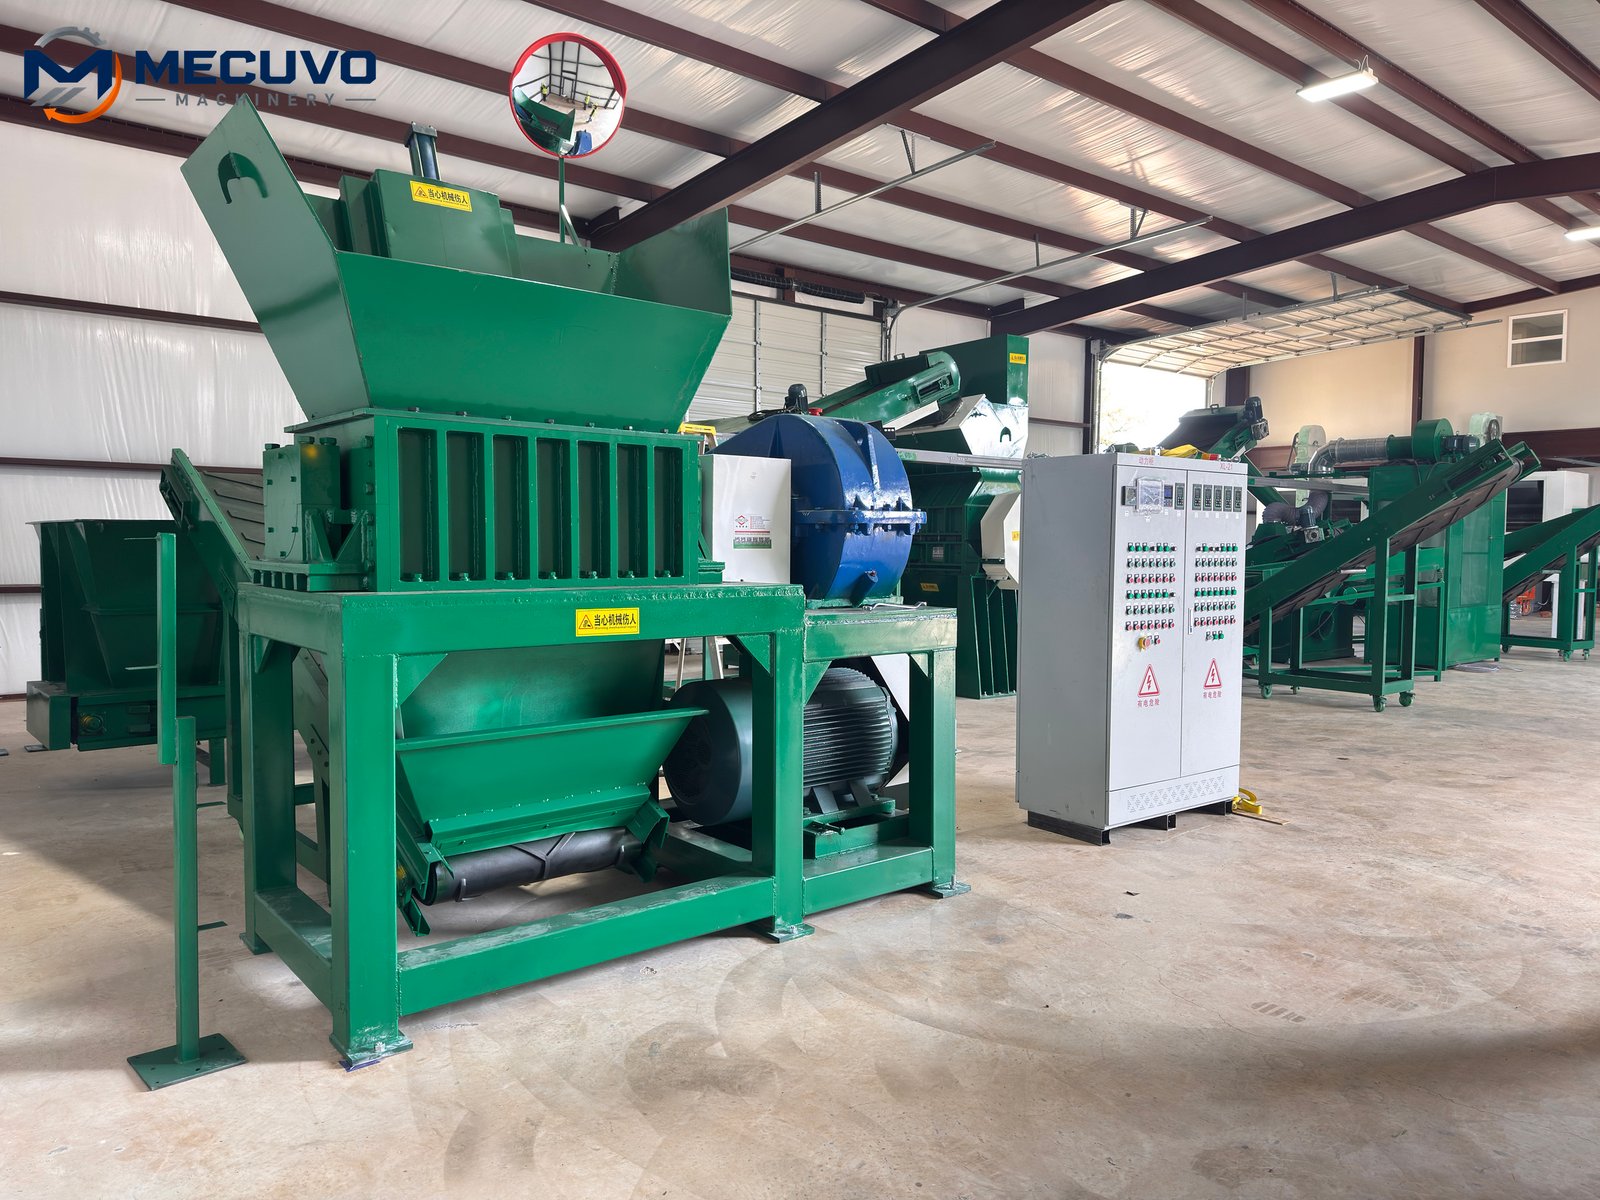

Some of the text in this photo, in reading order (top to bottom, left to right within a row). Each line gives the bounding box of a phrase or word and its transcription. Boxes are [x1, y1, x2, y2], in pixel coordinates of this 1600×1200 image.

[428, 188, 468, 204] 当心机械伤人
[594, 613, 636, 626] 当心机械伤人
